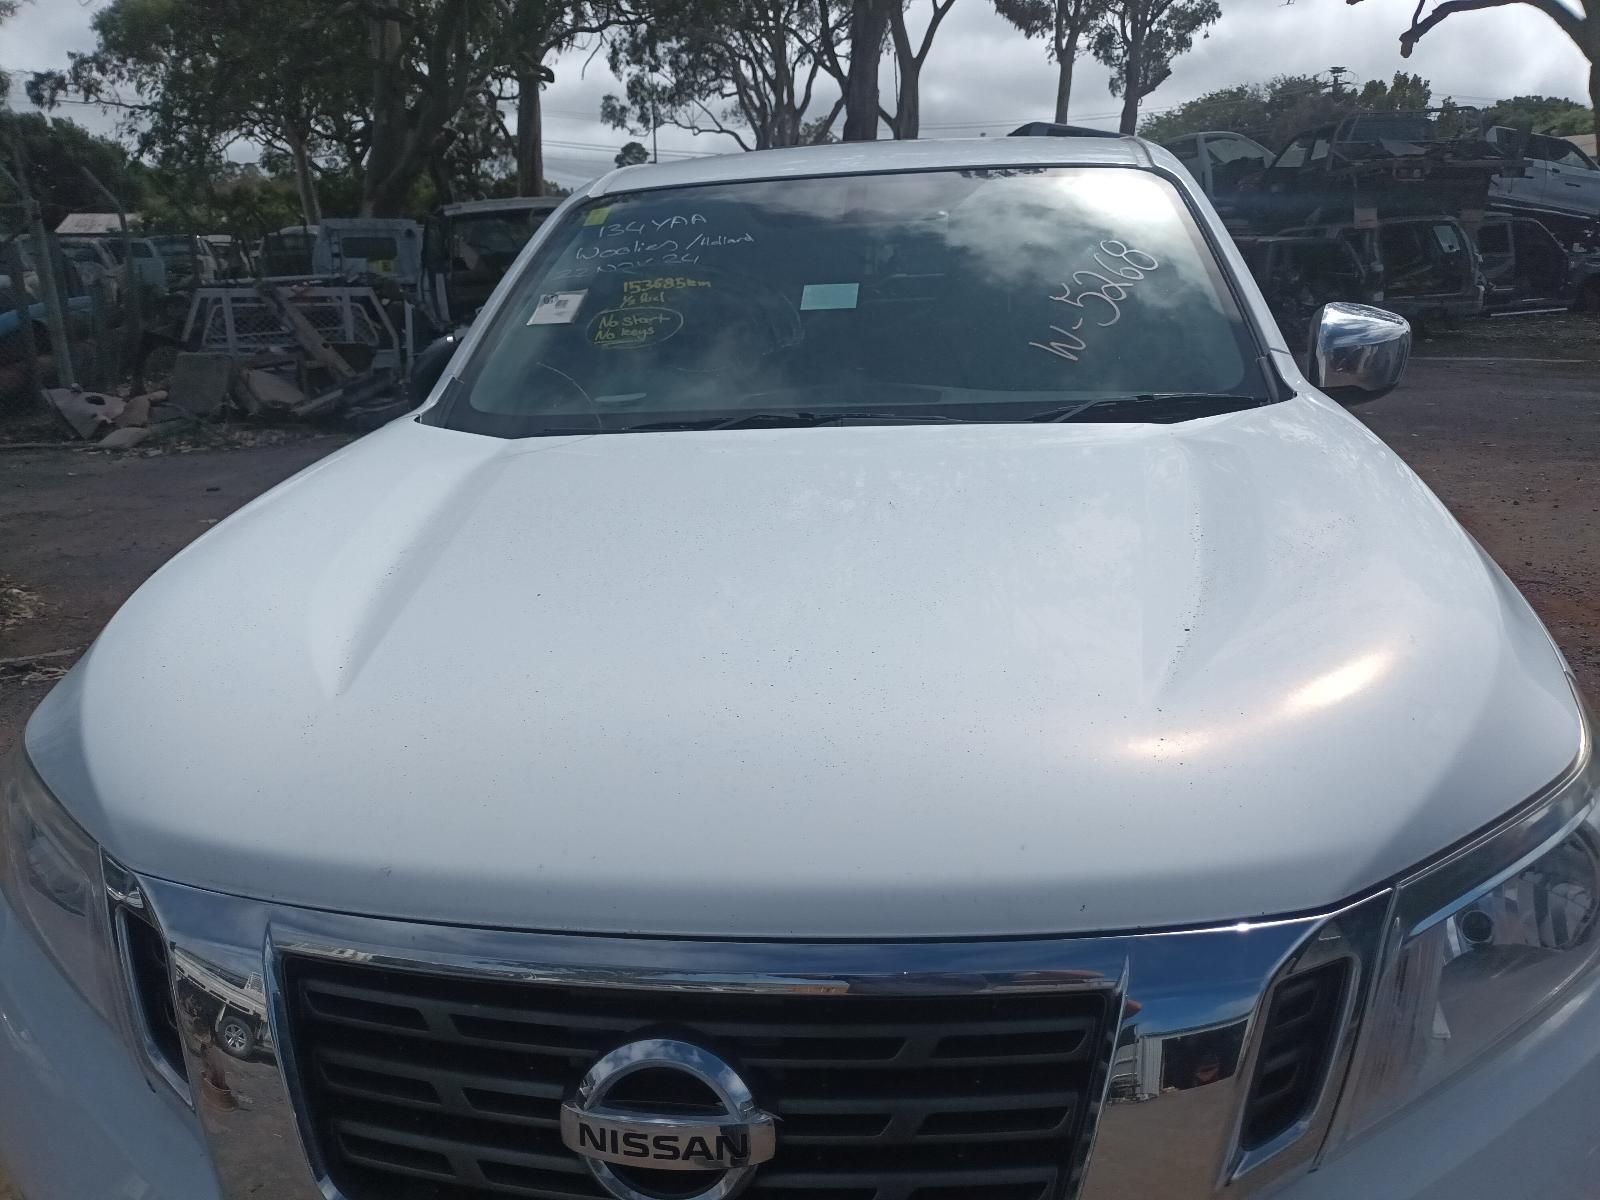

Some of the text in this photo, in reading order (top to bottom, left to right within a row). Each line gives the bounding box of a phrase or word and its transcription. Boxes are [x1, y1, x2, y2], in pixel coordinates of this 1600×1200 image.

[598, 313, 619, 328] No
[594, 328, 616, 341] No
[578, 1122, 748, 1161] NISSAN
